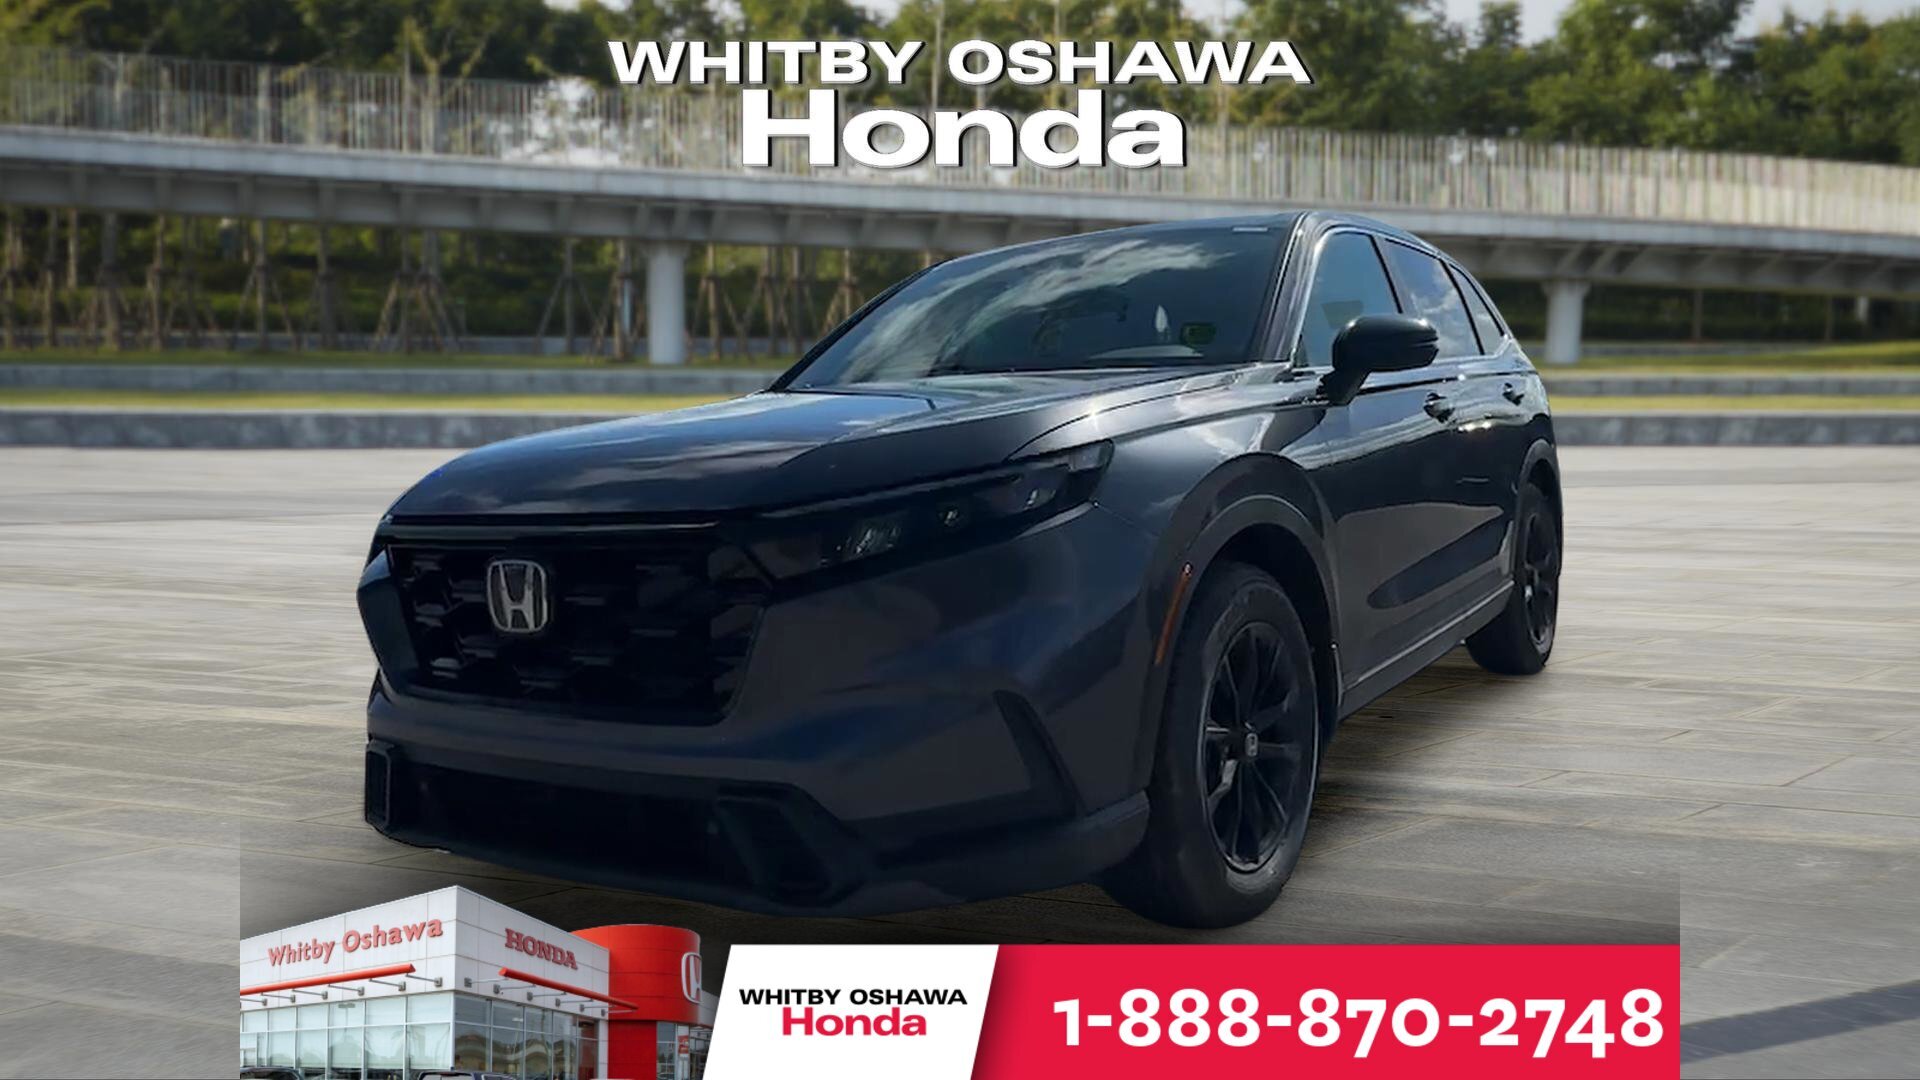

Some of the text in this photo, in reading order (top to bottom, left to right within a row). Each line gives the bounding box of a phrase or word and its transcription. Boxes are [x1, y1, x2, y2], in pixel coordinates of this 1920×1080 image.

[267, 918, 443, 967] Whitby Oshawa
[505, 928, 578, 970] HONDA
